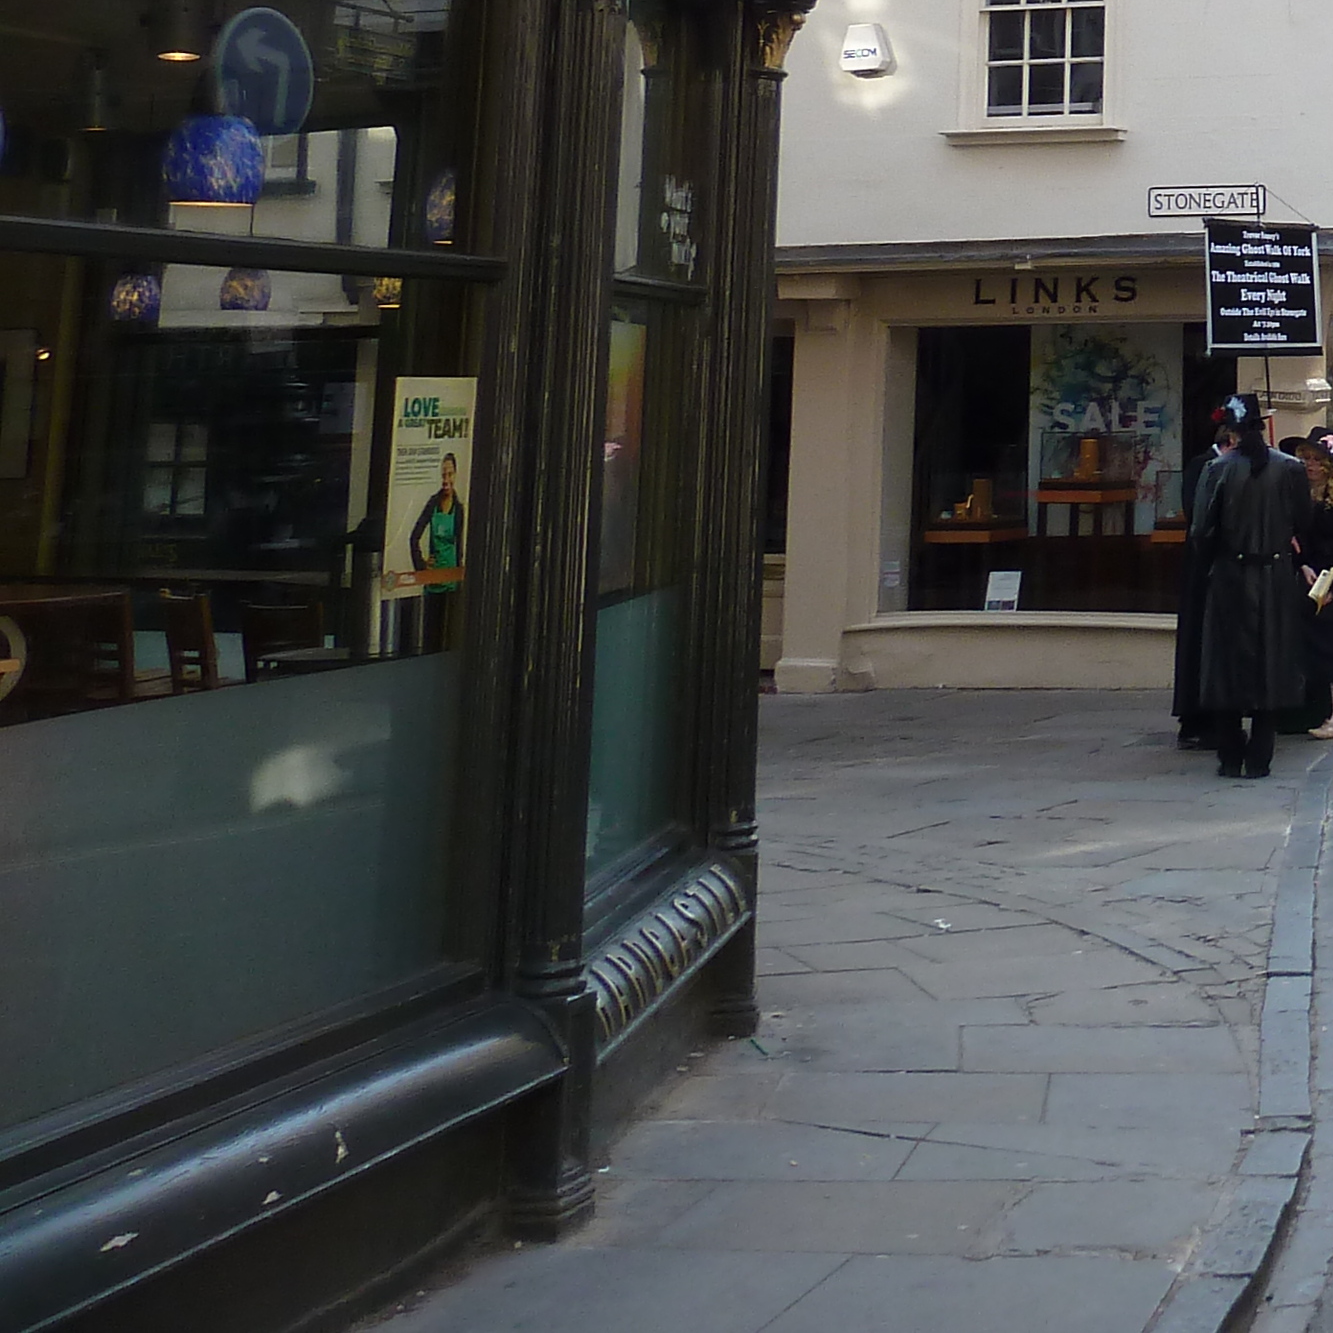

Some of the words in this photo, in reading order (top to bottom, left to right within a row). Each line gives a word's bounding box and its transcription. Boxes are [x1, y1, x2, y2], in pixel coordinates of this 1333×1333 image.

[842, 48, 877, 59] SECOM
[1154, 191, 1259, 211] STONEGATE
[1210, 242, 1241, 256] Amazing
[1241, 243, 1265, 255] Ghost
[1265, 244, 1282, 256] Walk
[1282, 245, 1291, 256] Of
[1292, 246, 1311, 256] York
[1211, 270, 1226, 282] The
[1226, 271, 1268, 283] Theatrical
[1268, 272, 1289, 283] Ghost
[1290, 273, 1311, 284] Walk
[973, 276, 1138, 304] LINKS
[1240, 288, 1266, 303] Every
[1266, 289, 1287, 304] Night
[1012, 305, 1098, 315] LONDON
[1242, 307, 1254, 316] The
[403, 397, 440, 417] LOVE
[1052, 400, 1161, 435] SALE
[427, 417, 469, 439] TEAM!
